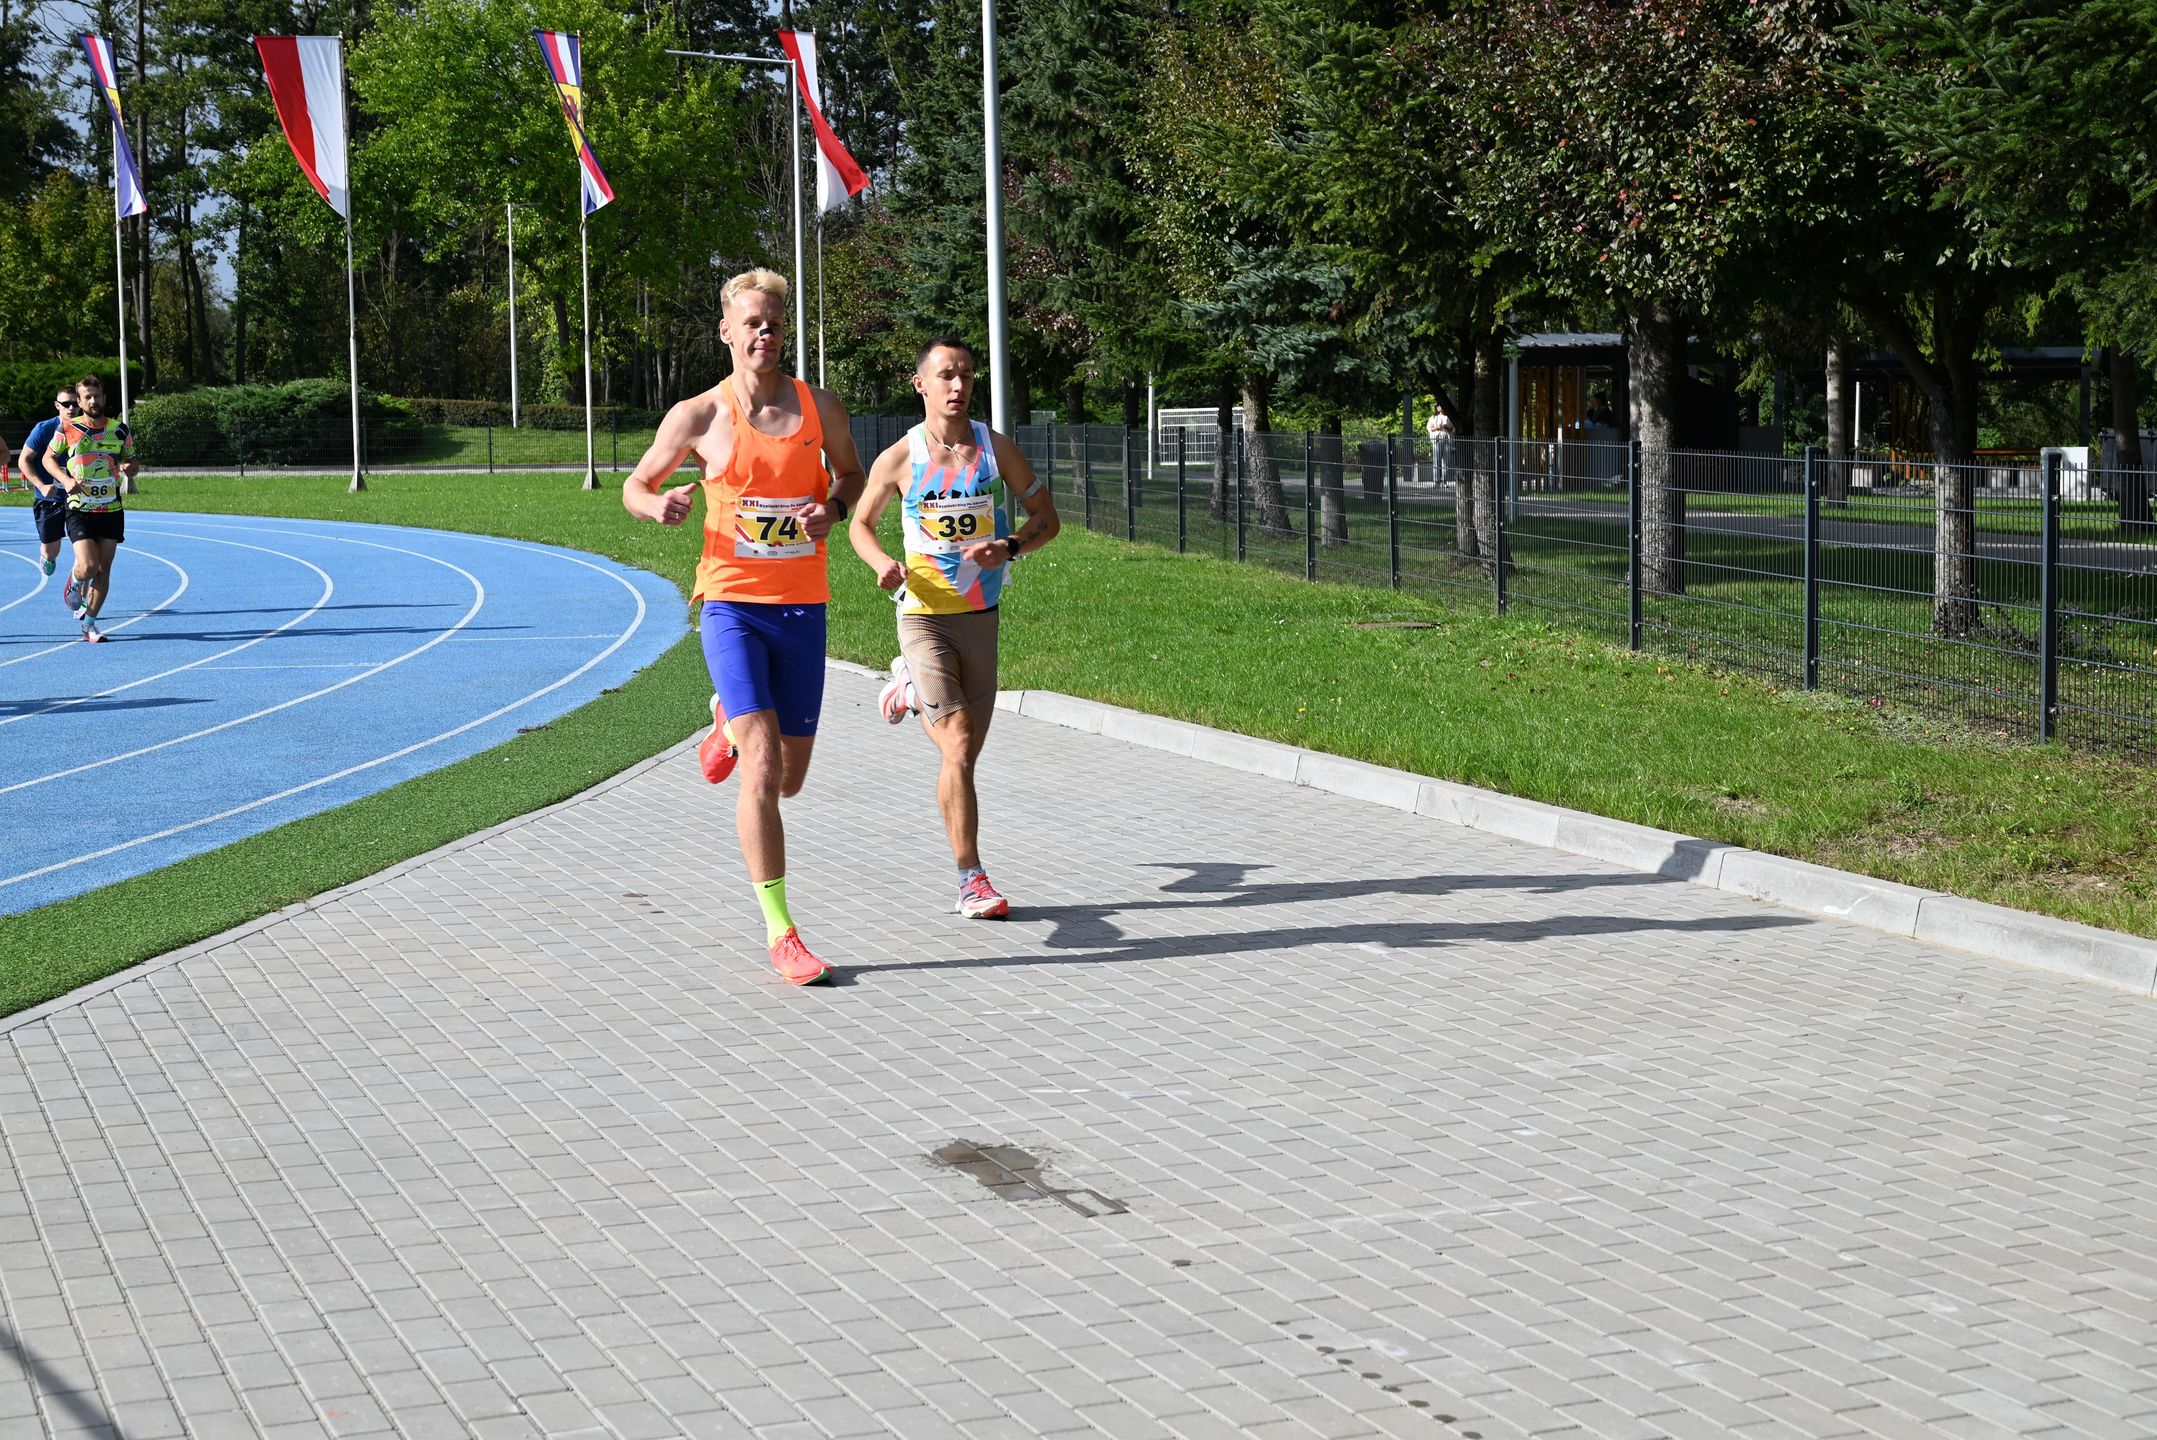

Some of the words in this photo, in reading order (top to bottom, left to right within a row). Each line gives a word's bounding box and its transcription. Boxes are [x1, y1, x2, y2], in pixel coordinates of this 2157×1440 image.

[90, 485, 108, 496] 86
[756, 516, 798, 541] 74
[938, 513, 977, 538] 39
